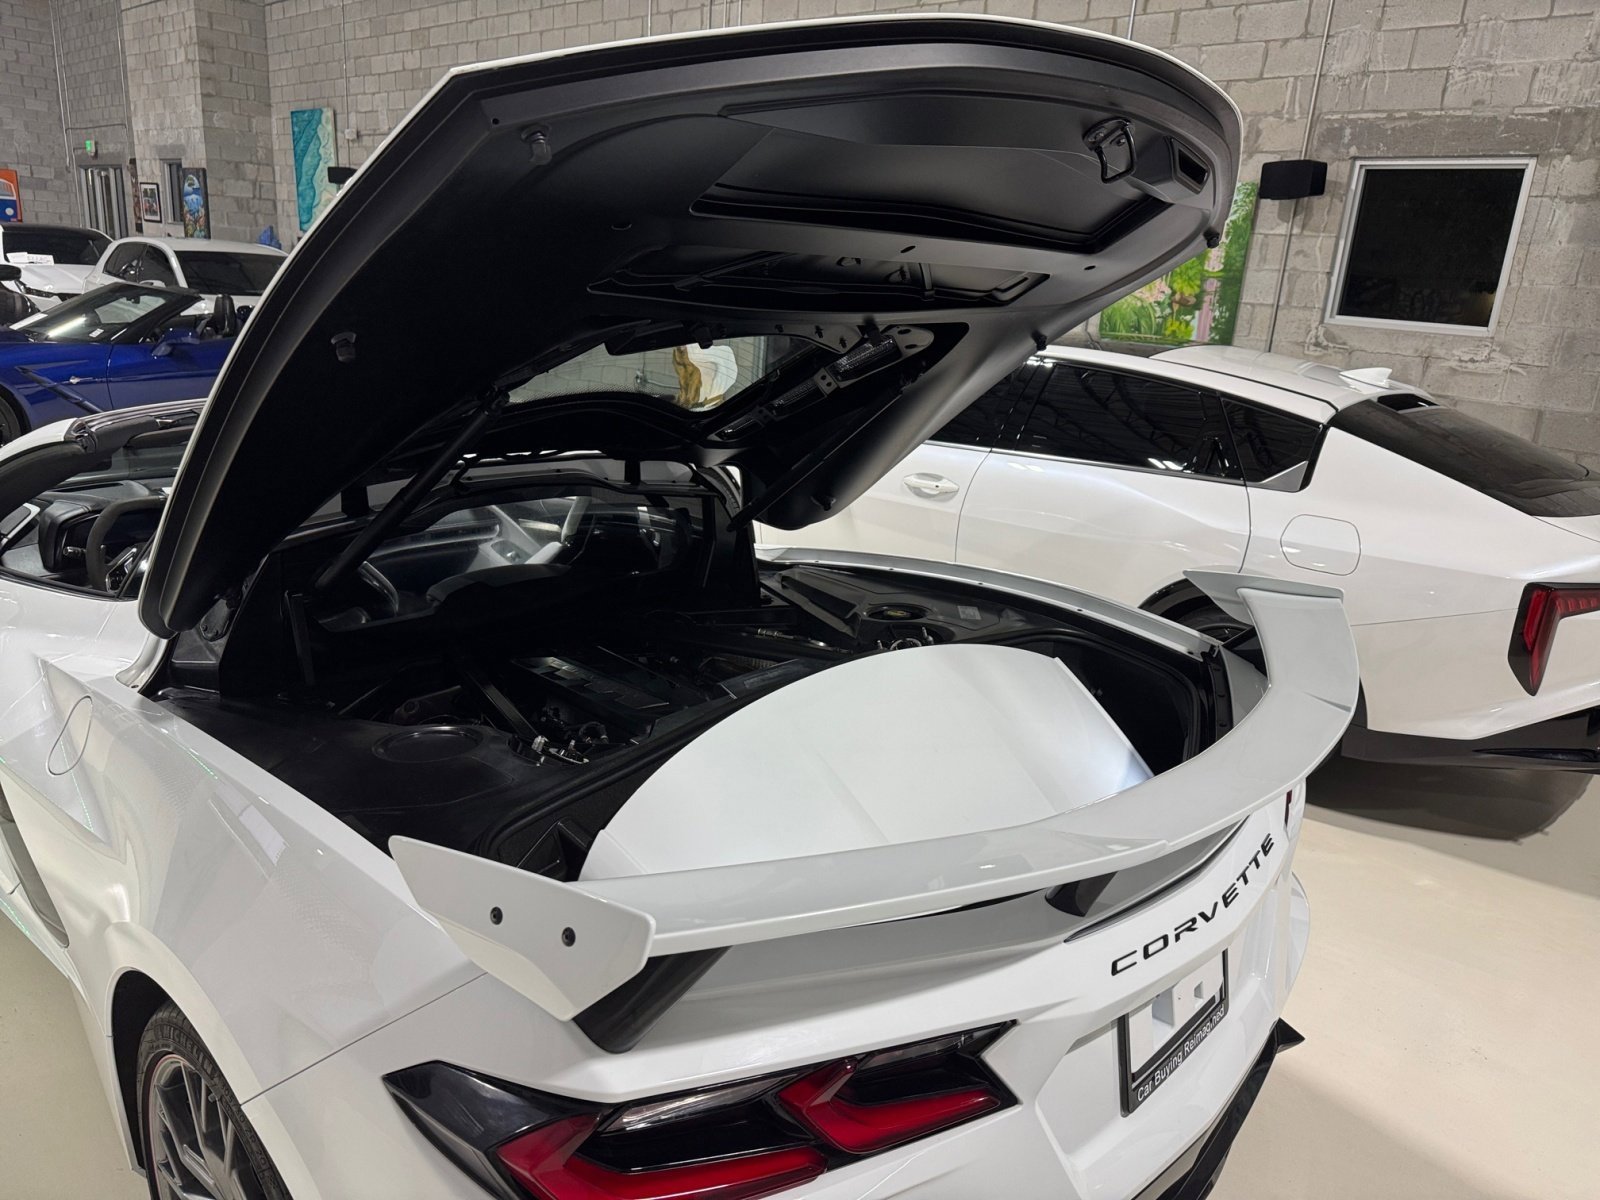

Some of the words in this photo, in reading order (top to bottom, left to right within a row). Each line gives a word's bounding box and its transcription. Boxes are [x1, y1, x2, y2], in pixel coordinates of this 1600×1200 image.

[1111, 833, 1274, 976] CORVETTE
[163, 1025, 216, 1077] MICHELIN
[1137, 1080, 1152, 1101] Car
[1154, 1051, 1183, 1085] Buying
[1184, 1004, 1225, 1056] Reimagined
